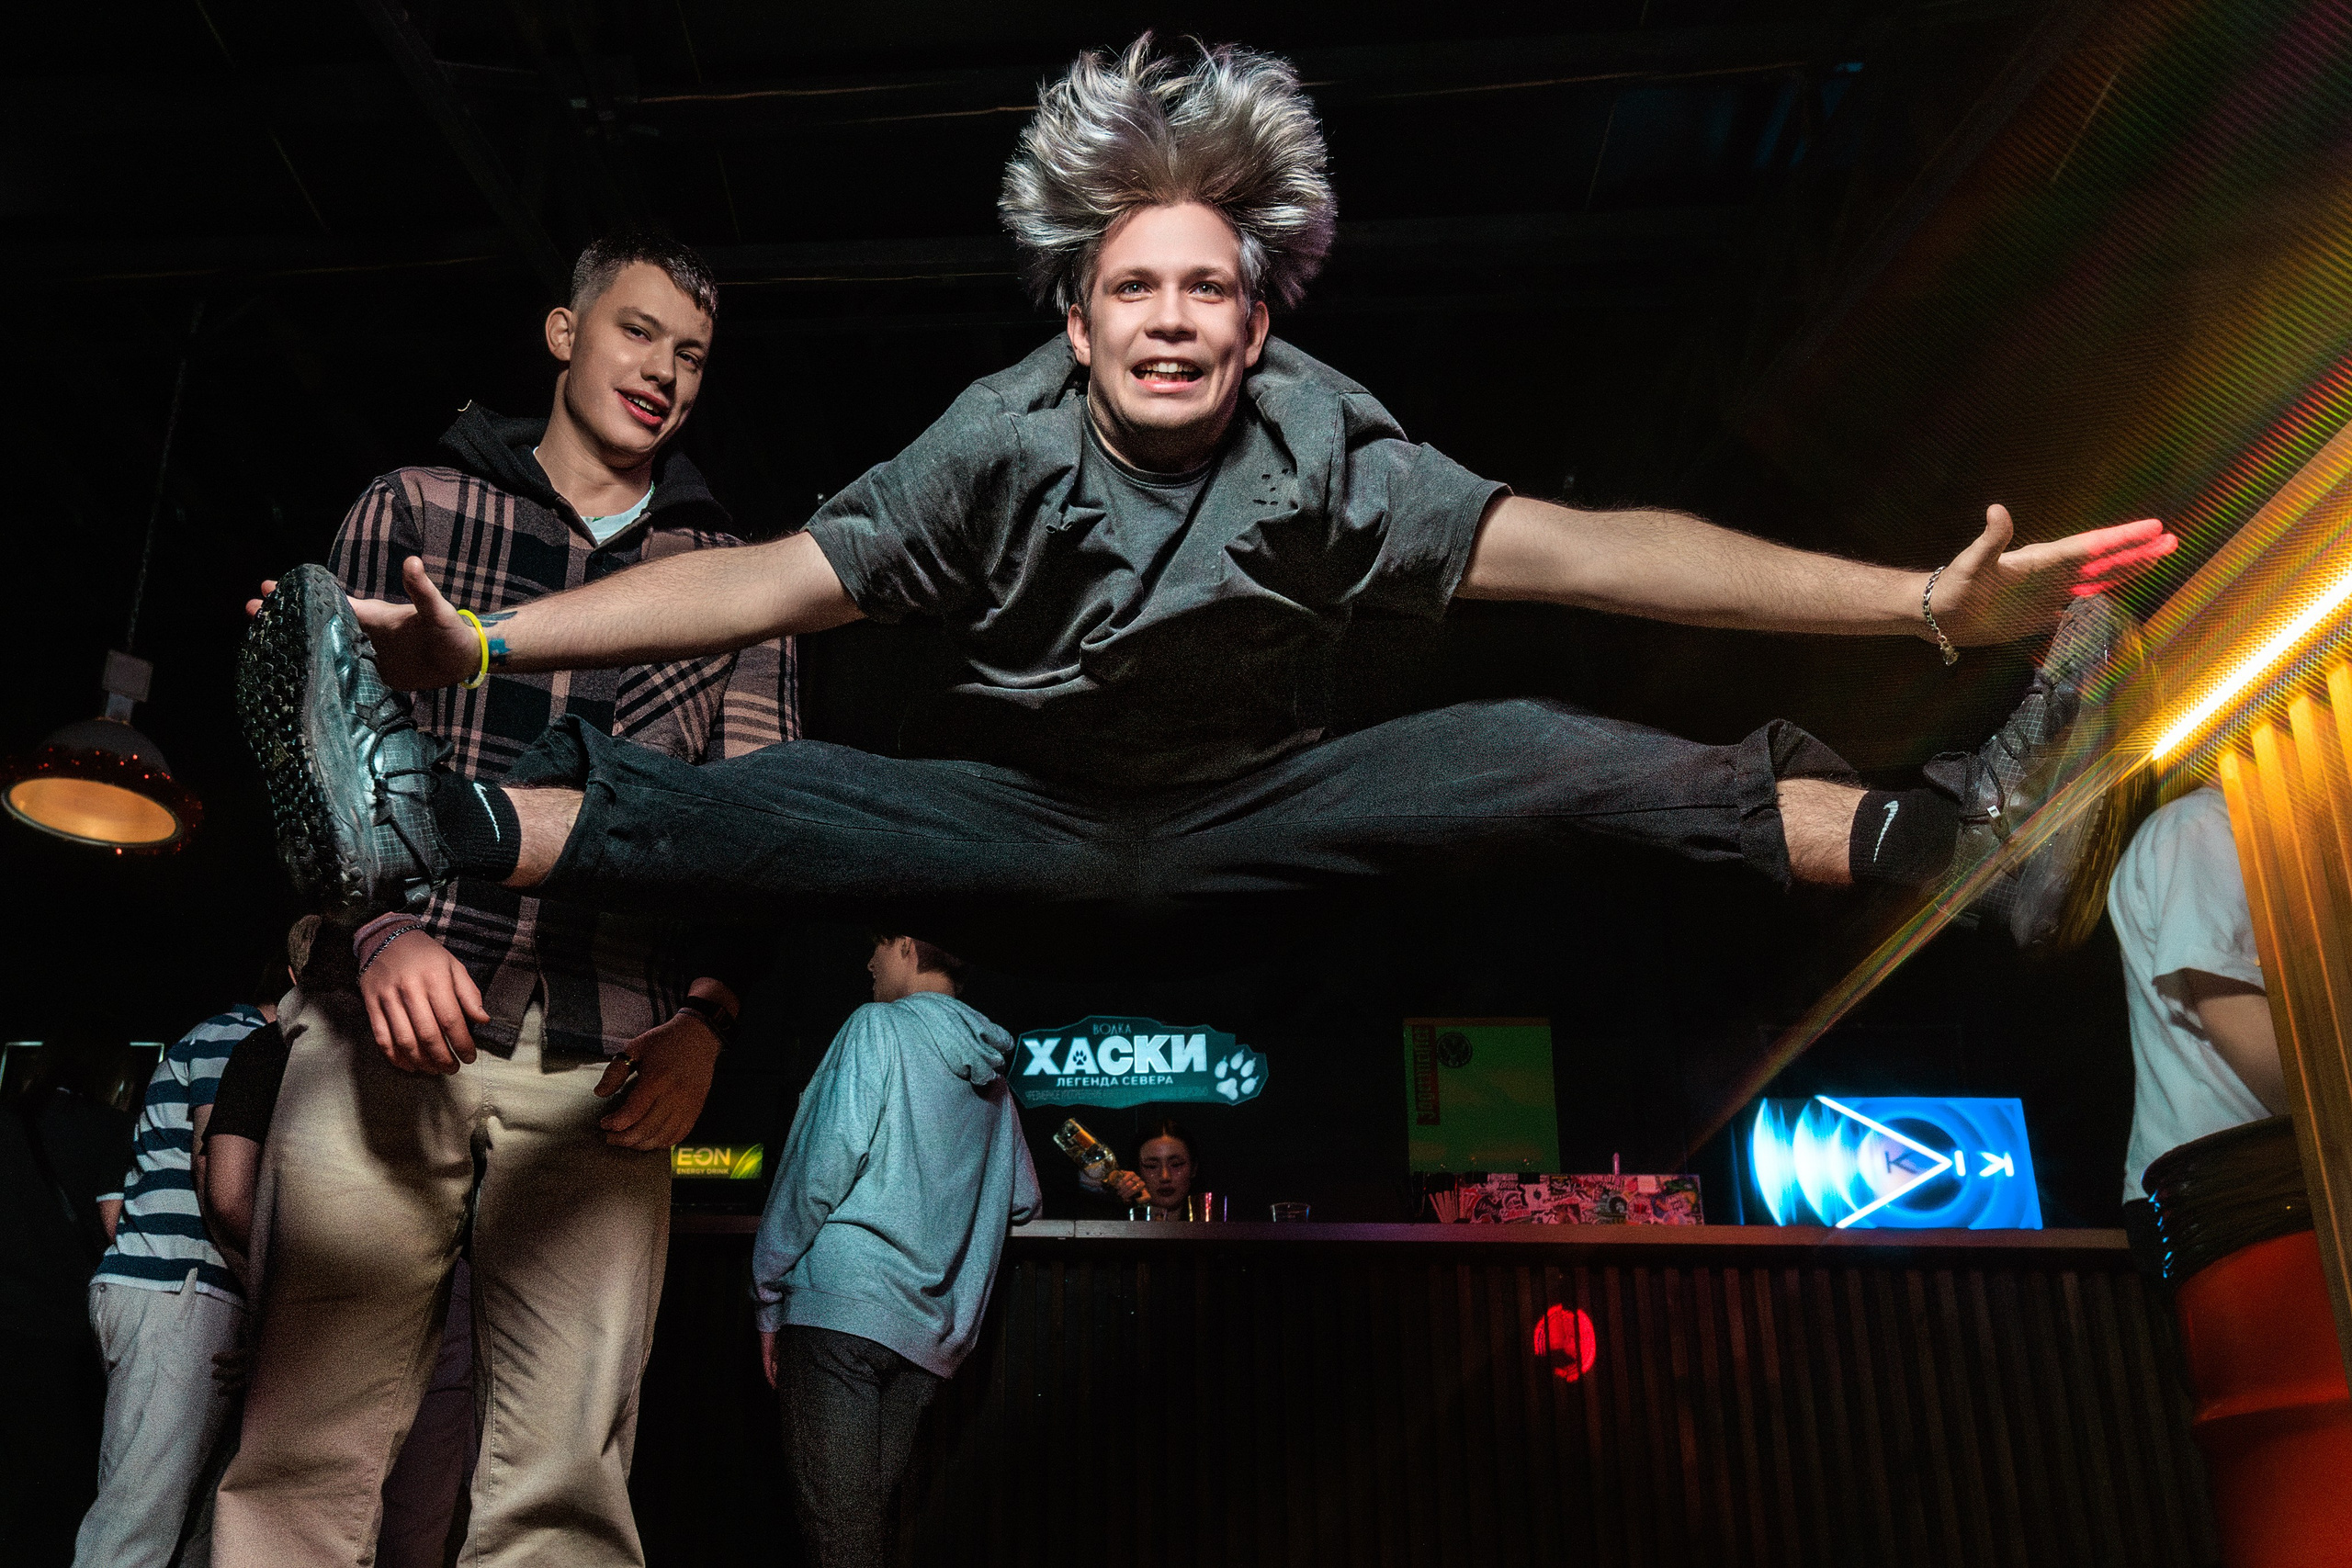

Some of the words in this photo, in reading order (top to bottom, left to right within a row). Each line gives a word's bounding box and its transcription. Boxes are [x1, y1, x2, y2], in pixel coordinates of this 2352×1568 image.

[1092, 1022, 1132, 1035] ВОДКА
[1023, 1033, 1207, 1076] ХАСКИ
[1057, 1077, 1119, 1088] ЛЕГЕНДА
[1122, 1075, 1174, 1086] СЕВЕРА
[677, 1147, 731, 1166] EON
